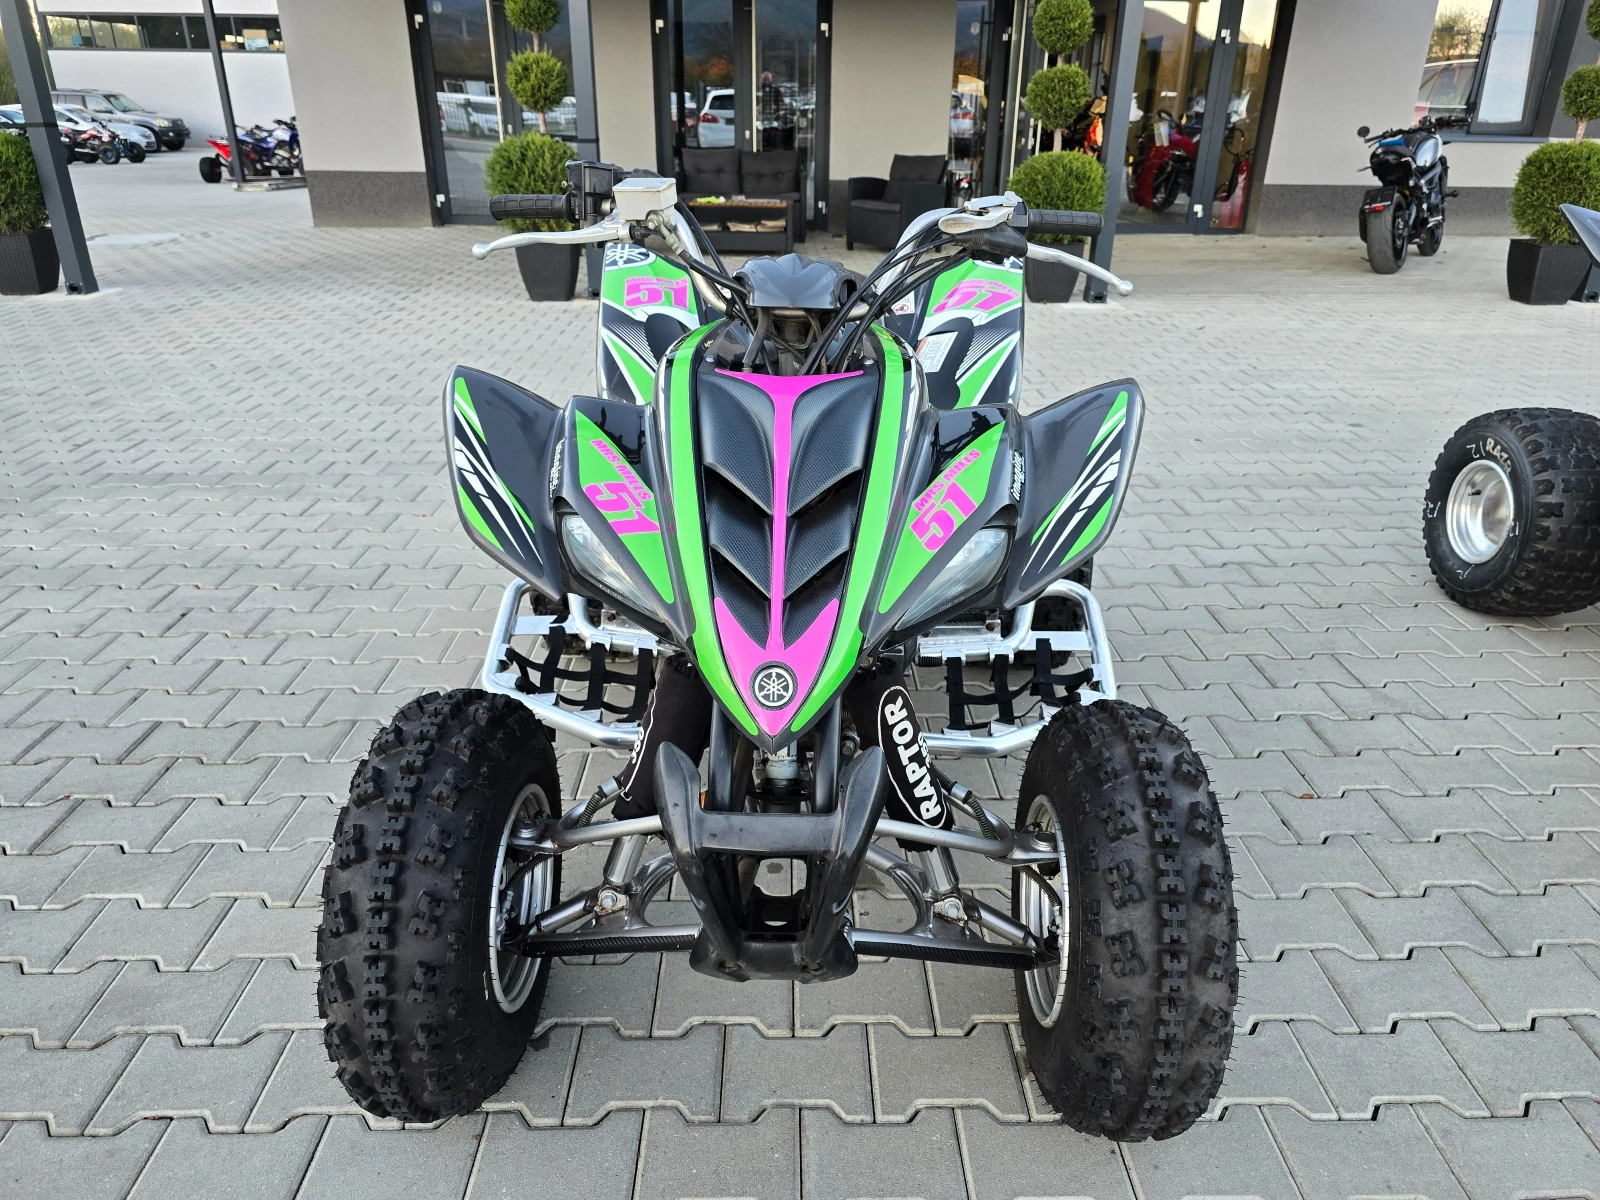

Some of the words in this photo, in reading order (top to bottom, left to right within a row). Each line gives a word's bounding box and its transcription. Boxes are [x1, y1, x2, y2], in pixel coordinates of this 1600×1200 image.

[624, 282, 688, 310] 51
[589, 438, 622, 469] MRS
[614, 464, 654, 502] MILLS
[912, 481, 945, 513] MRS
[942, 448, 982, 482] MILLS
[583, 481, 661, 537] 51
[909, 481, 978, 553] 51
[883, 696, 942, 821] RAPTOR
